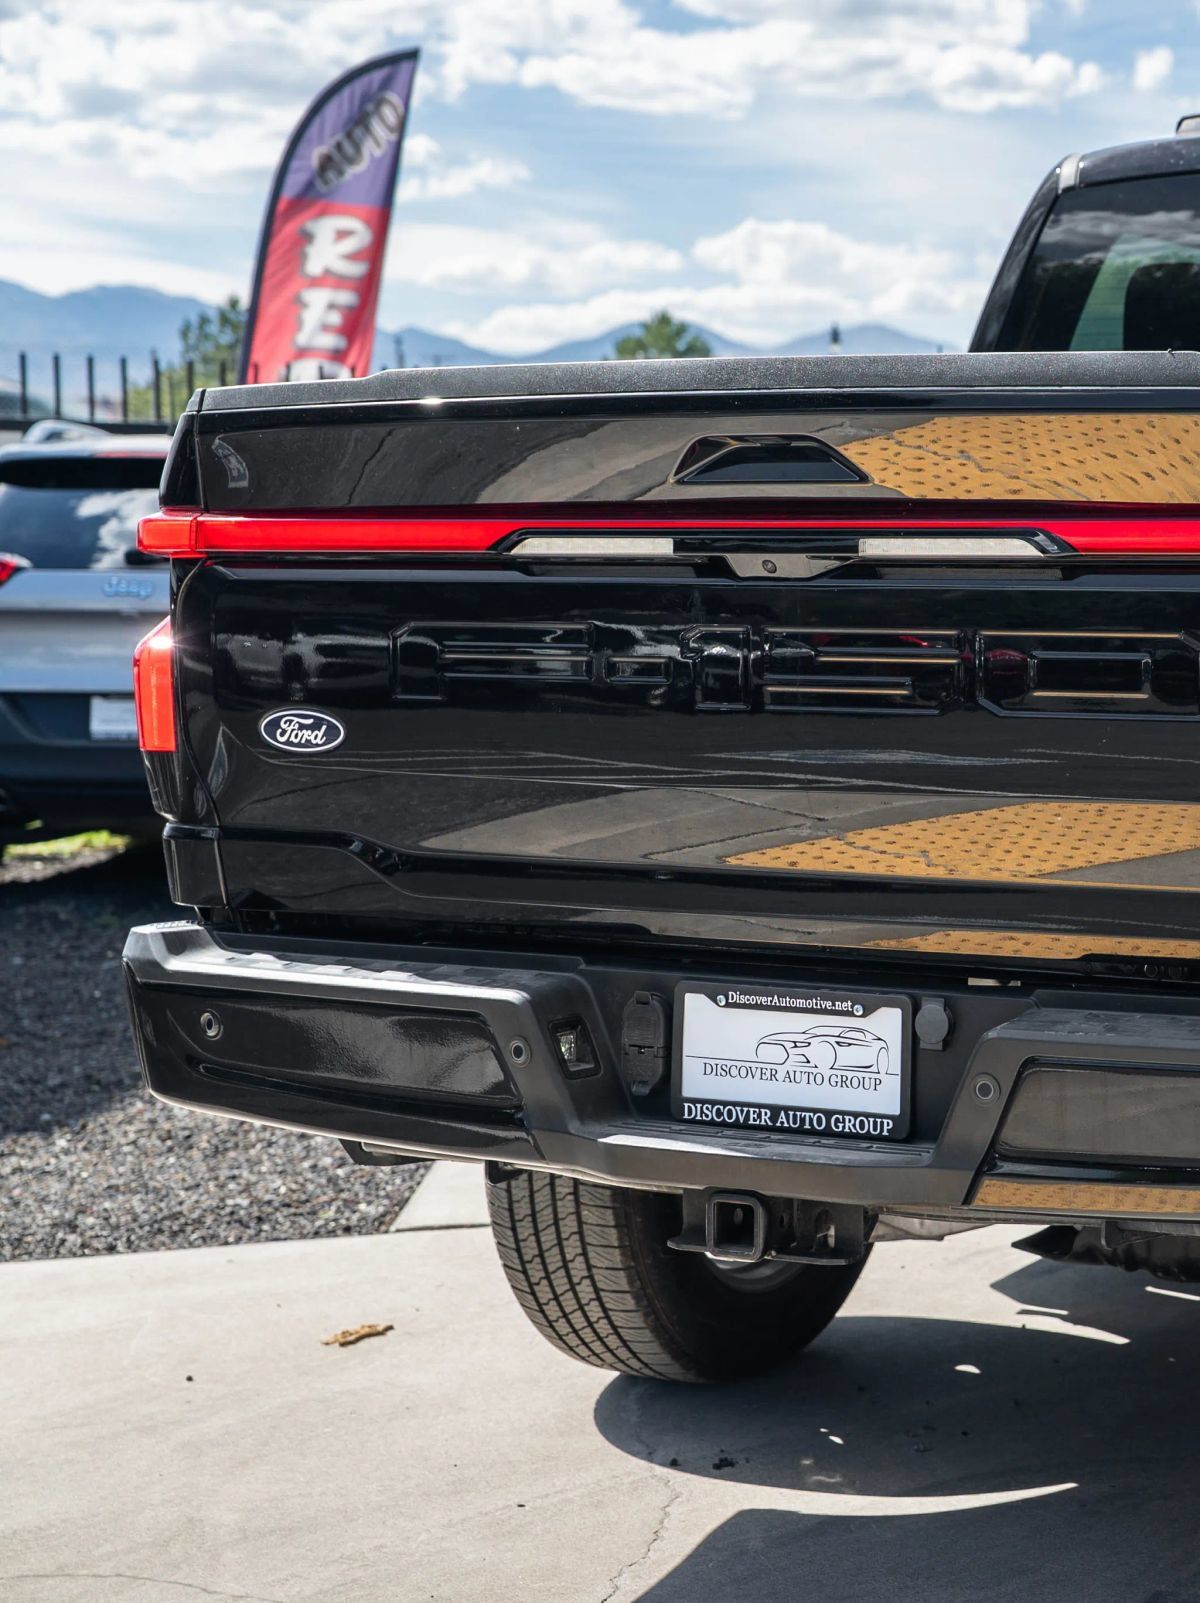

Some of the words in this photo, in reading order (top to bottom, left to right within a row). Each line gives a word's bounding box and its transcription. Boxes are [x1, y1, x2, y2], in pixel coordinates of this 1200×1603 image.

[312, 91, 405, 191] AUTO
[276, 716, 327, 744] Ford
[728, 991, 853, 1012] DiscoverAutomotive.net
[703, 1062, 779, 1082] DISCOVER
[782, 1071, 825, 1087] AUTO
[828, 1073, 882, 1092] GROUP
[683, 1103, 773, 1126] DISCOVER
[776, 1110, 827, 1130] AUTO
[830, 1114, 894, 1136] GROUP
